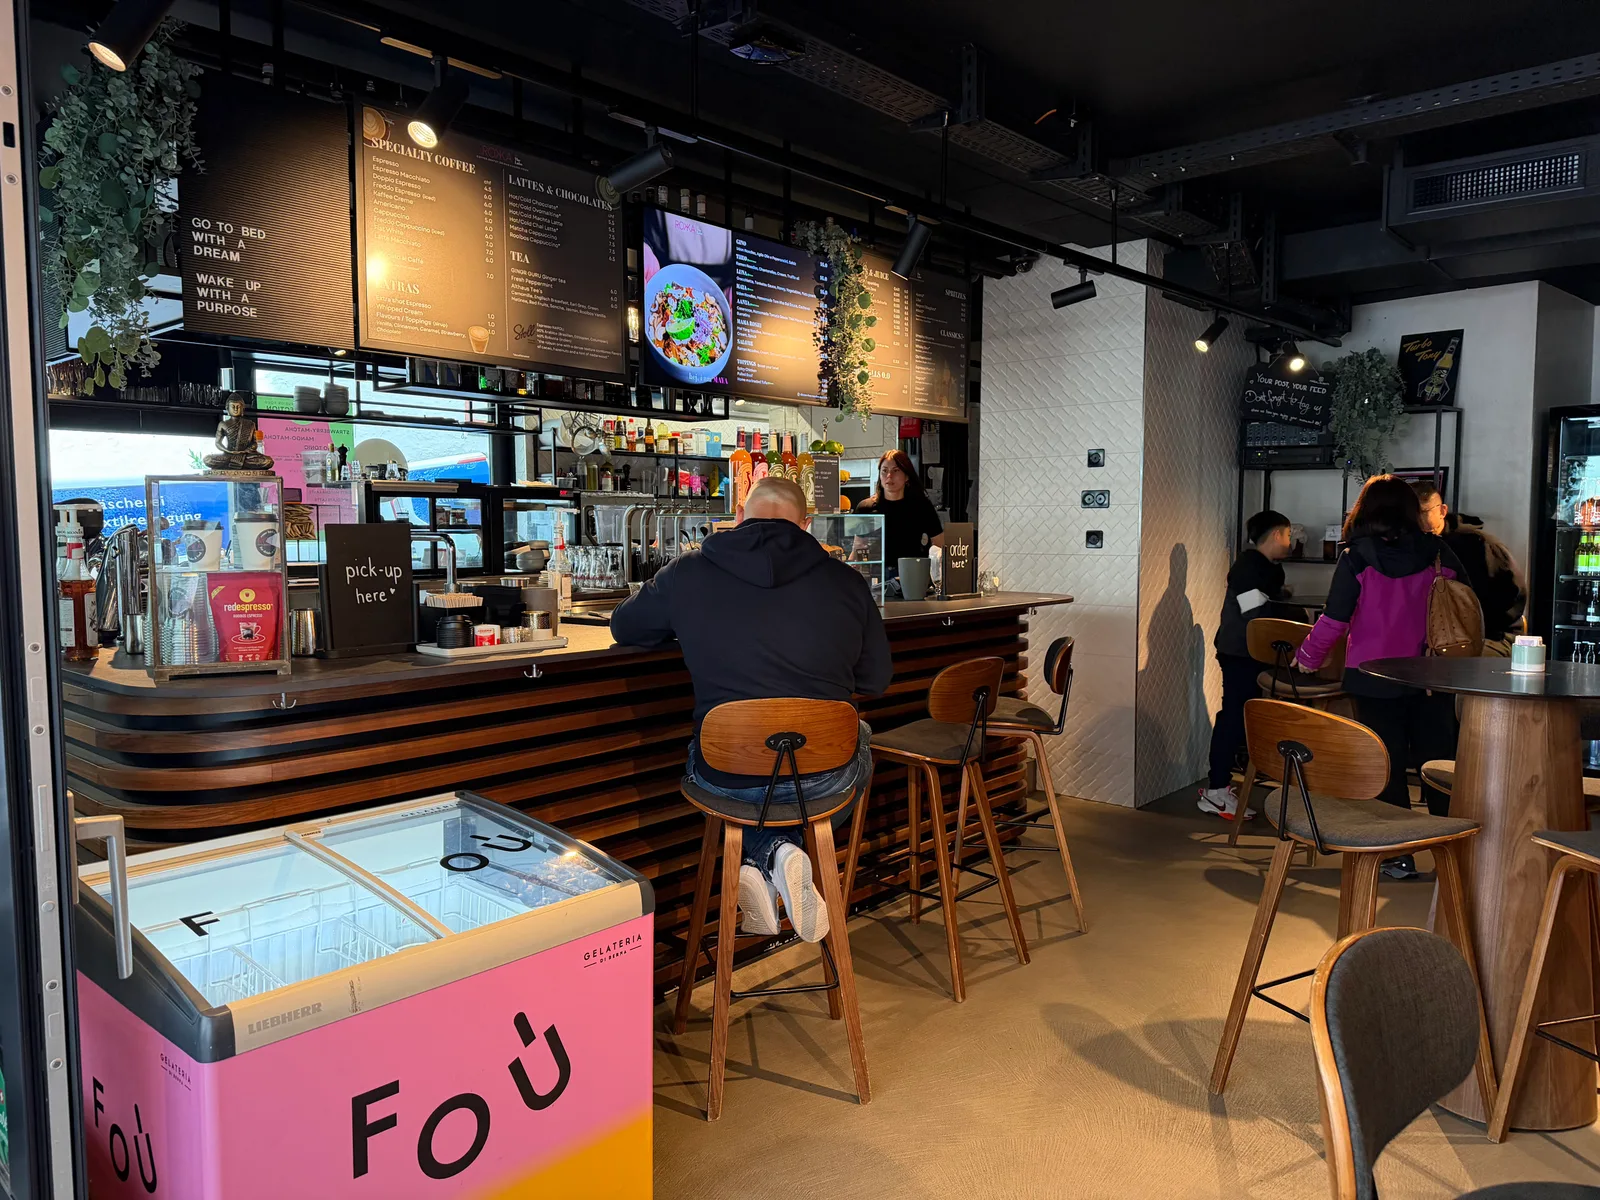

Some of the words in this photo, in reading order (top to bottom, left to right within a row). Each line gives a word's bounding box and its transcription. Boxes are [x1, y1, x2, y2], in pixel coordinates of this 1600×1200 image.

[372, 137, 432, 163] SPECIALTY
[435, 155, 476, 174] COFFEE
[373, 156, 399, 168] Espresso
[373, 165, 399, 176] Espresso
[400, 172, 430, 184] Macchiato
[373, 173, 394, 184] Doppio
[396, 179, 421, 190] Espresso
[373, 182, 394, 191] Freddo
[395, 188, 420, 198] Espresso
[508, 174, 544, 193] LATTES
[546, 186, 554, 194] &
[555, 186, 612, 211] CHOCOLATES
[374, 200, 405, 211] Americano
[509, 194, 532, 203] Hot/Cold
[509, 201, 531, 211] Hot/Cold
[374, 208, 409, 220] Cappuccino
[509, 209, 532, 219] Hot/Cold
[509, 217, 532, 226] Hot/Cold
[192, 217, 211, 230] GO
[216, 222, 234, 234] TO
[242, 226, 266, 239] BED
[509, 224, 527, 234] Matcha
[529, 228, 557, 241] Cappuccino
[192, 231, 225, 246] WITH
[238, 239, 246, 249] A
[510, 232, 528, 241] Rooibos
[194, 245, 240, 262] DREAM
[510, 250, 530, 264] TEA
[196, 273, 234, 288] WAKE
[245, 280, 261, 291] UP
[196, 287, 231, 300] WITH
[241, 293, 249, 303] A
[197, 301, 258, 317] PURPOSE
[376, 304, 402, 313] Whipped
[404, 308, 423, 316] Cream
[406, 317, 431, 326] Toppings
[1403, 337, 1432, 353] Turbo
[1415, 349, 1442, 362] Tony
[1256, 372, 1272, 385] YOUR
[1274, 379, 1289, 388] POST,
[1292, 383, 1307, 391] YOUR
[950, 537, 969, 557] order
[345, 556, 402, 585] pick-up
[356, 588, 388, 604] here
[584, 934, 642, 961] GELATERIA
[248, 1002, 322, 1035] LIEBHERR
[160, 1053, 191, 1084] GELATERIA
